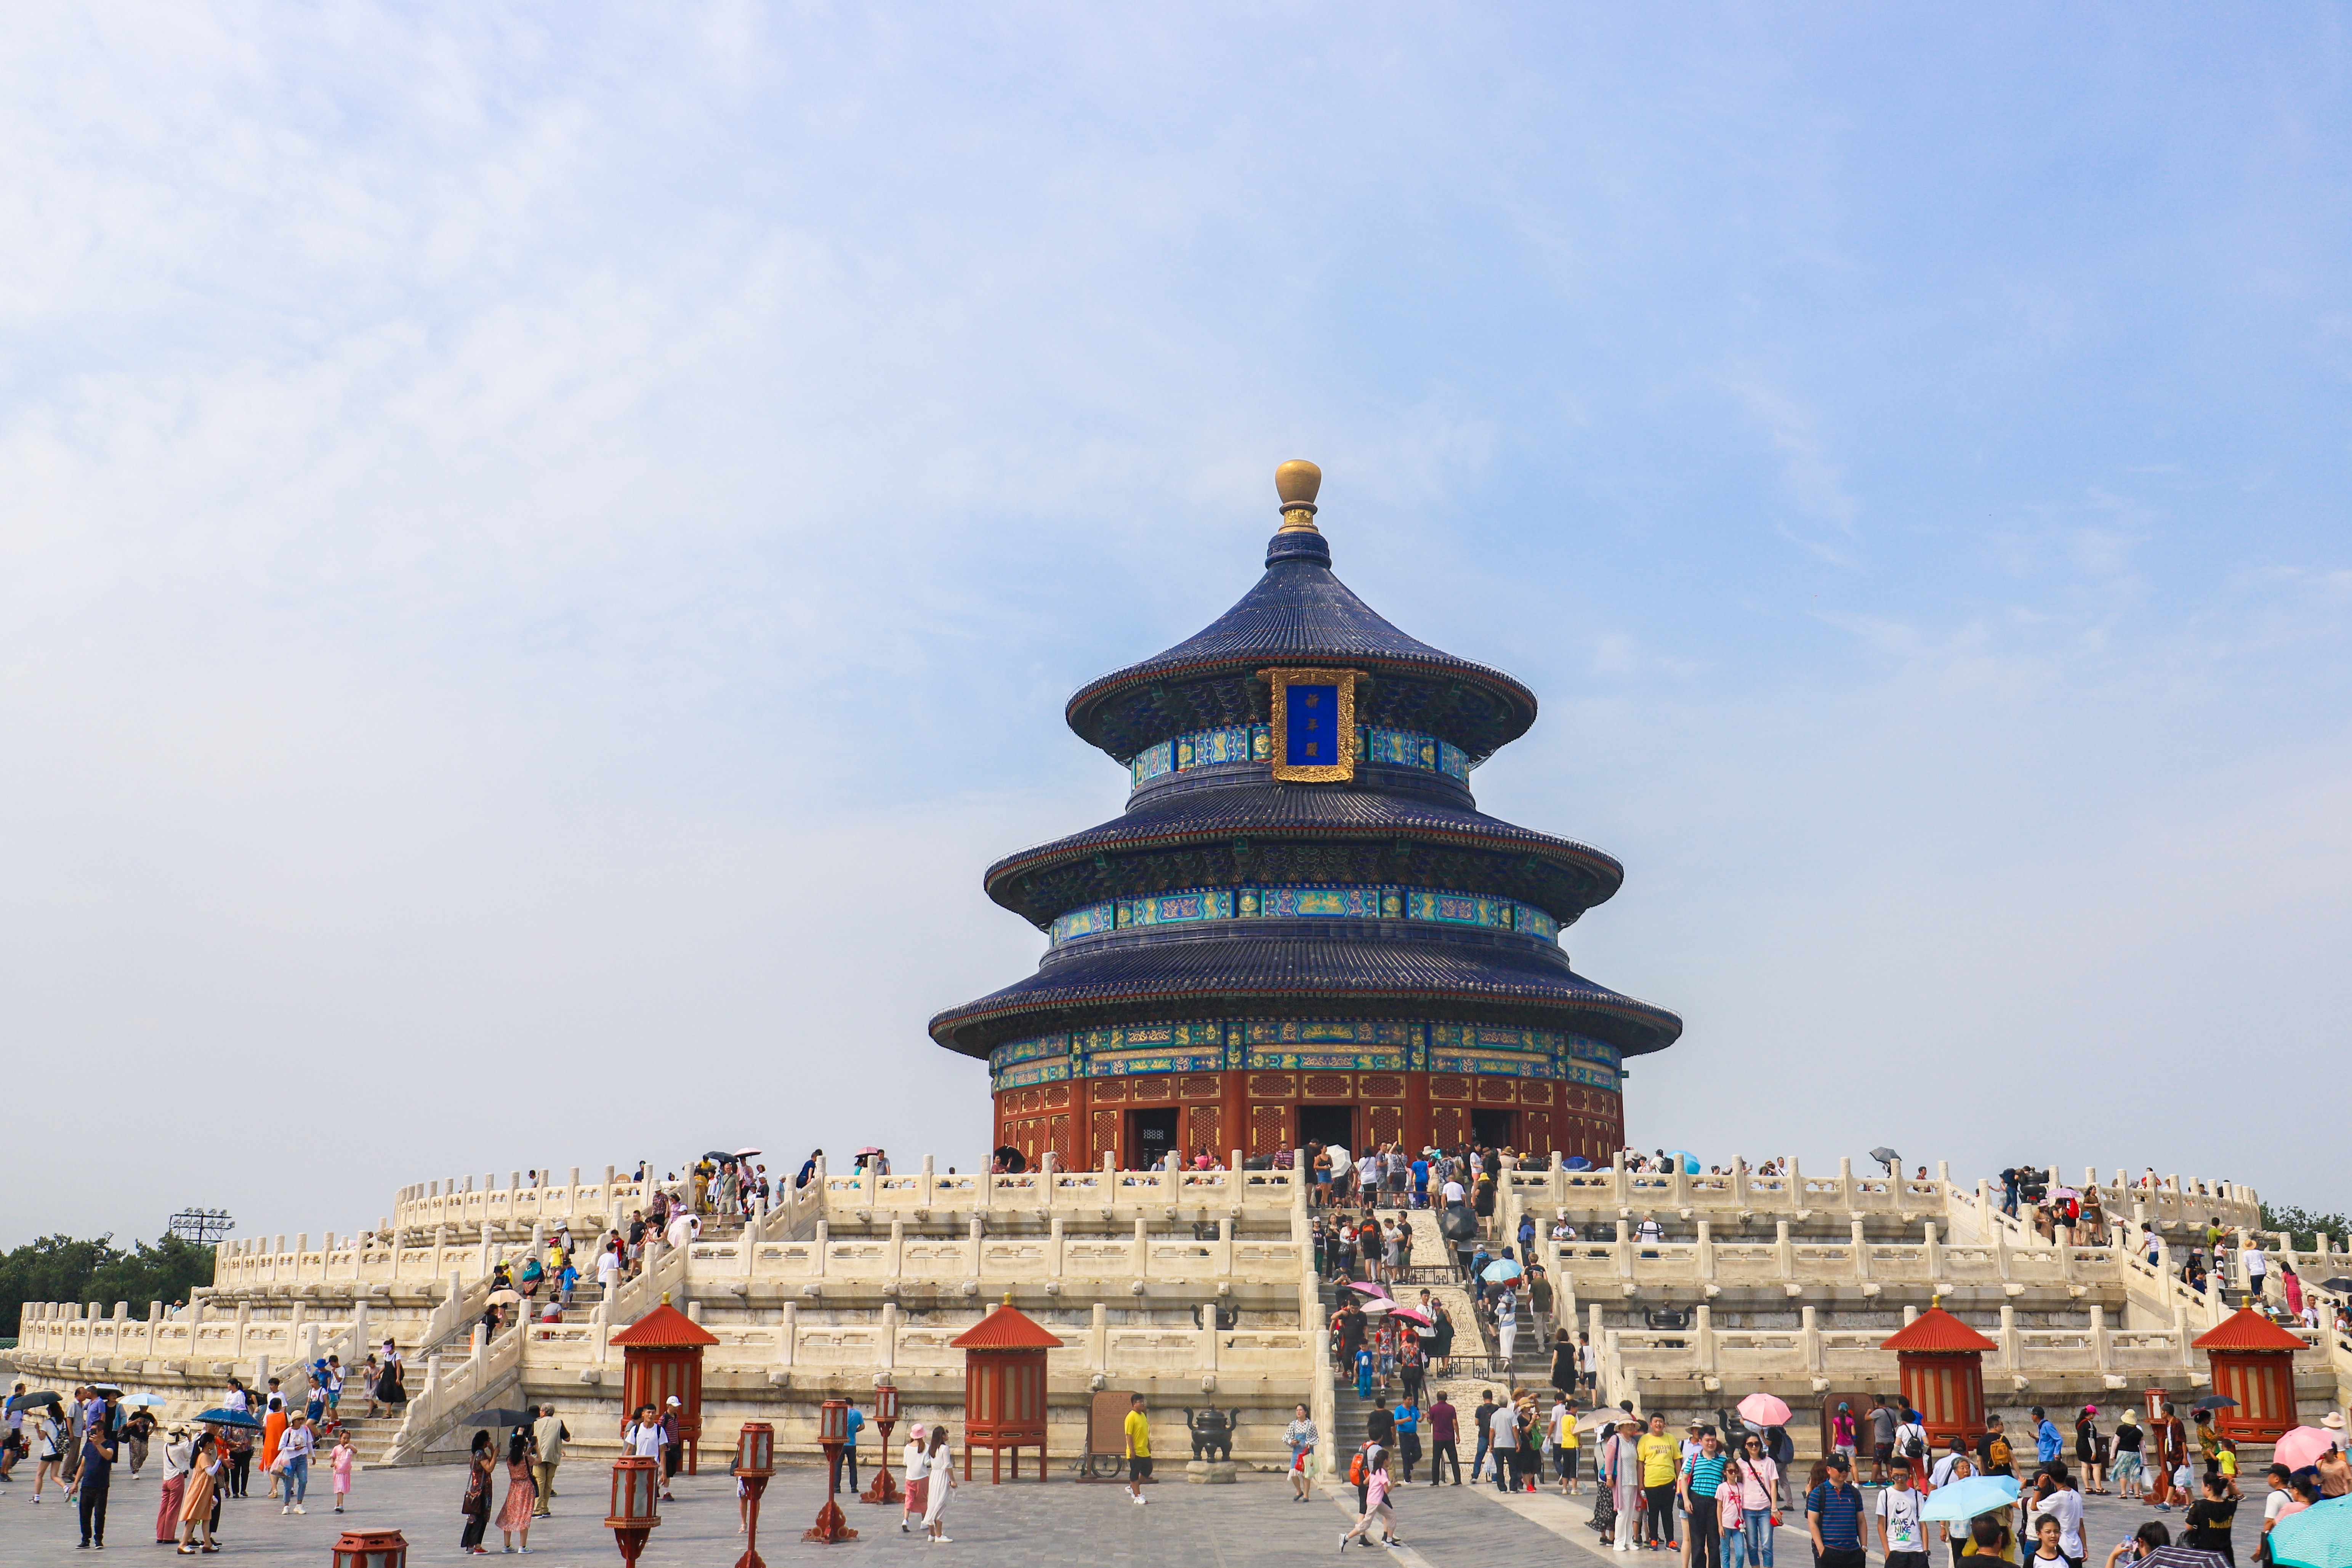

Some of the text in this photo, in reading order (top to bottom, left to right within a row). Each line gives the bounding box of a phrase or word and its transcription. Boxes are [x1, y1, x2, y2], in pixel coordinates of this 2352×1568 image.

[1305, 694, 1320, 757] 祈年殿
[1895, 1526, 1911, 1534] NIKE
[1896, 1532, 1910, 1541] DAY
